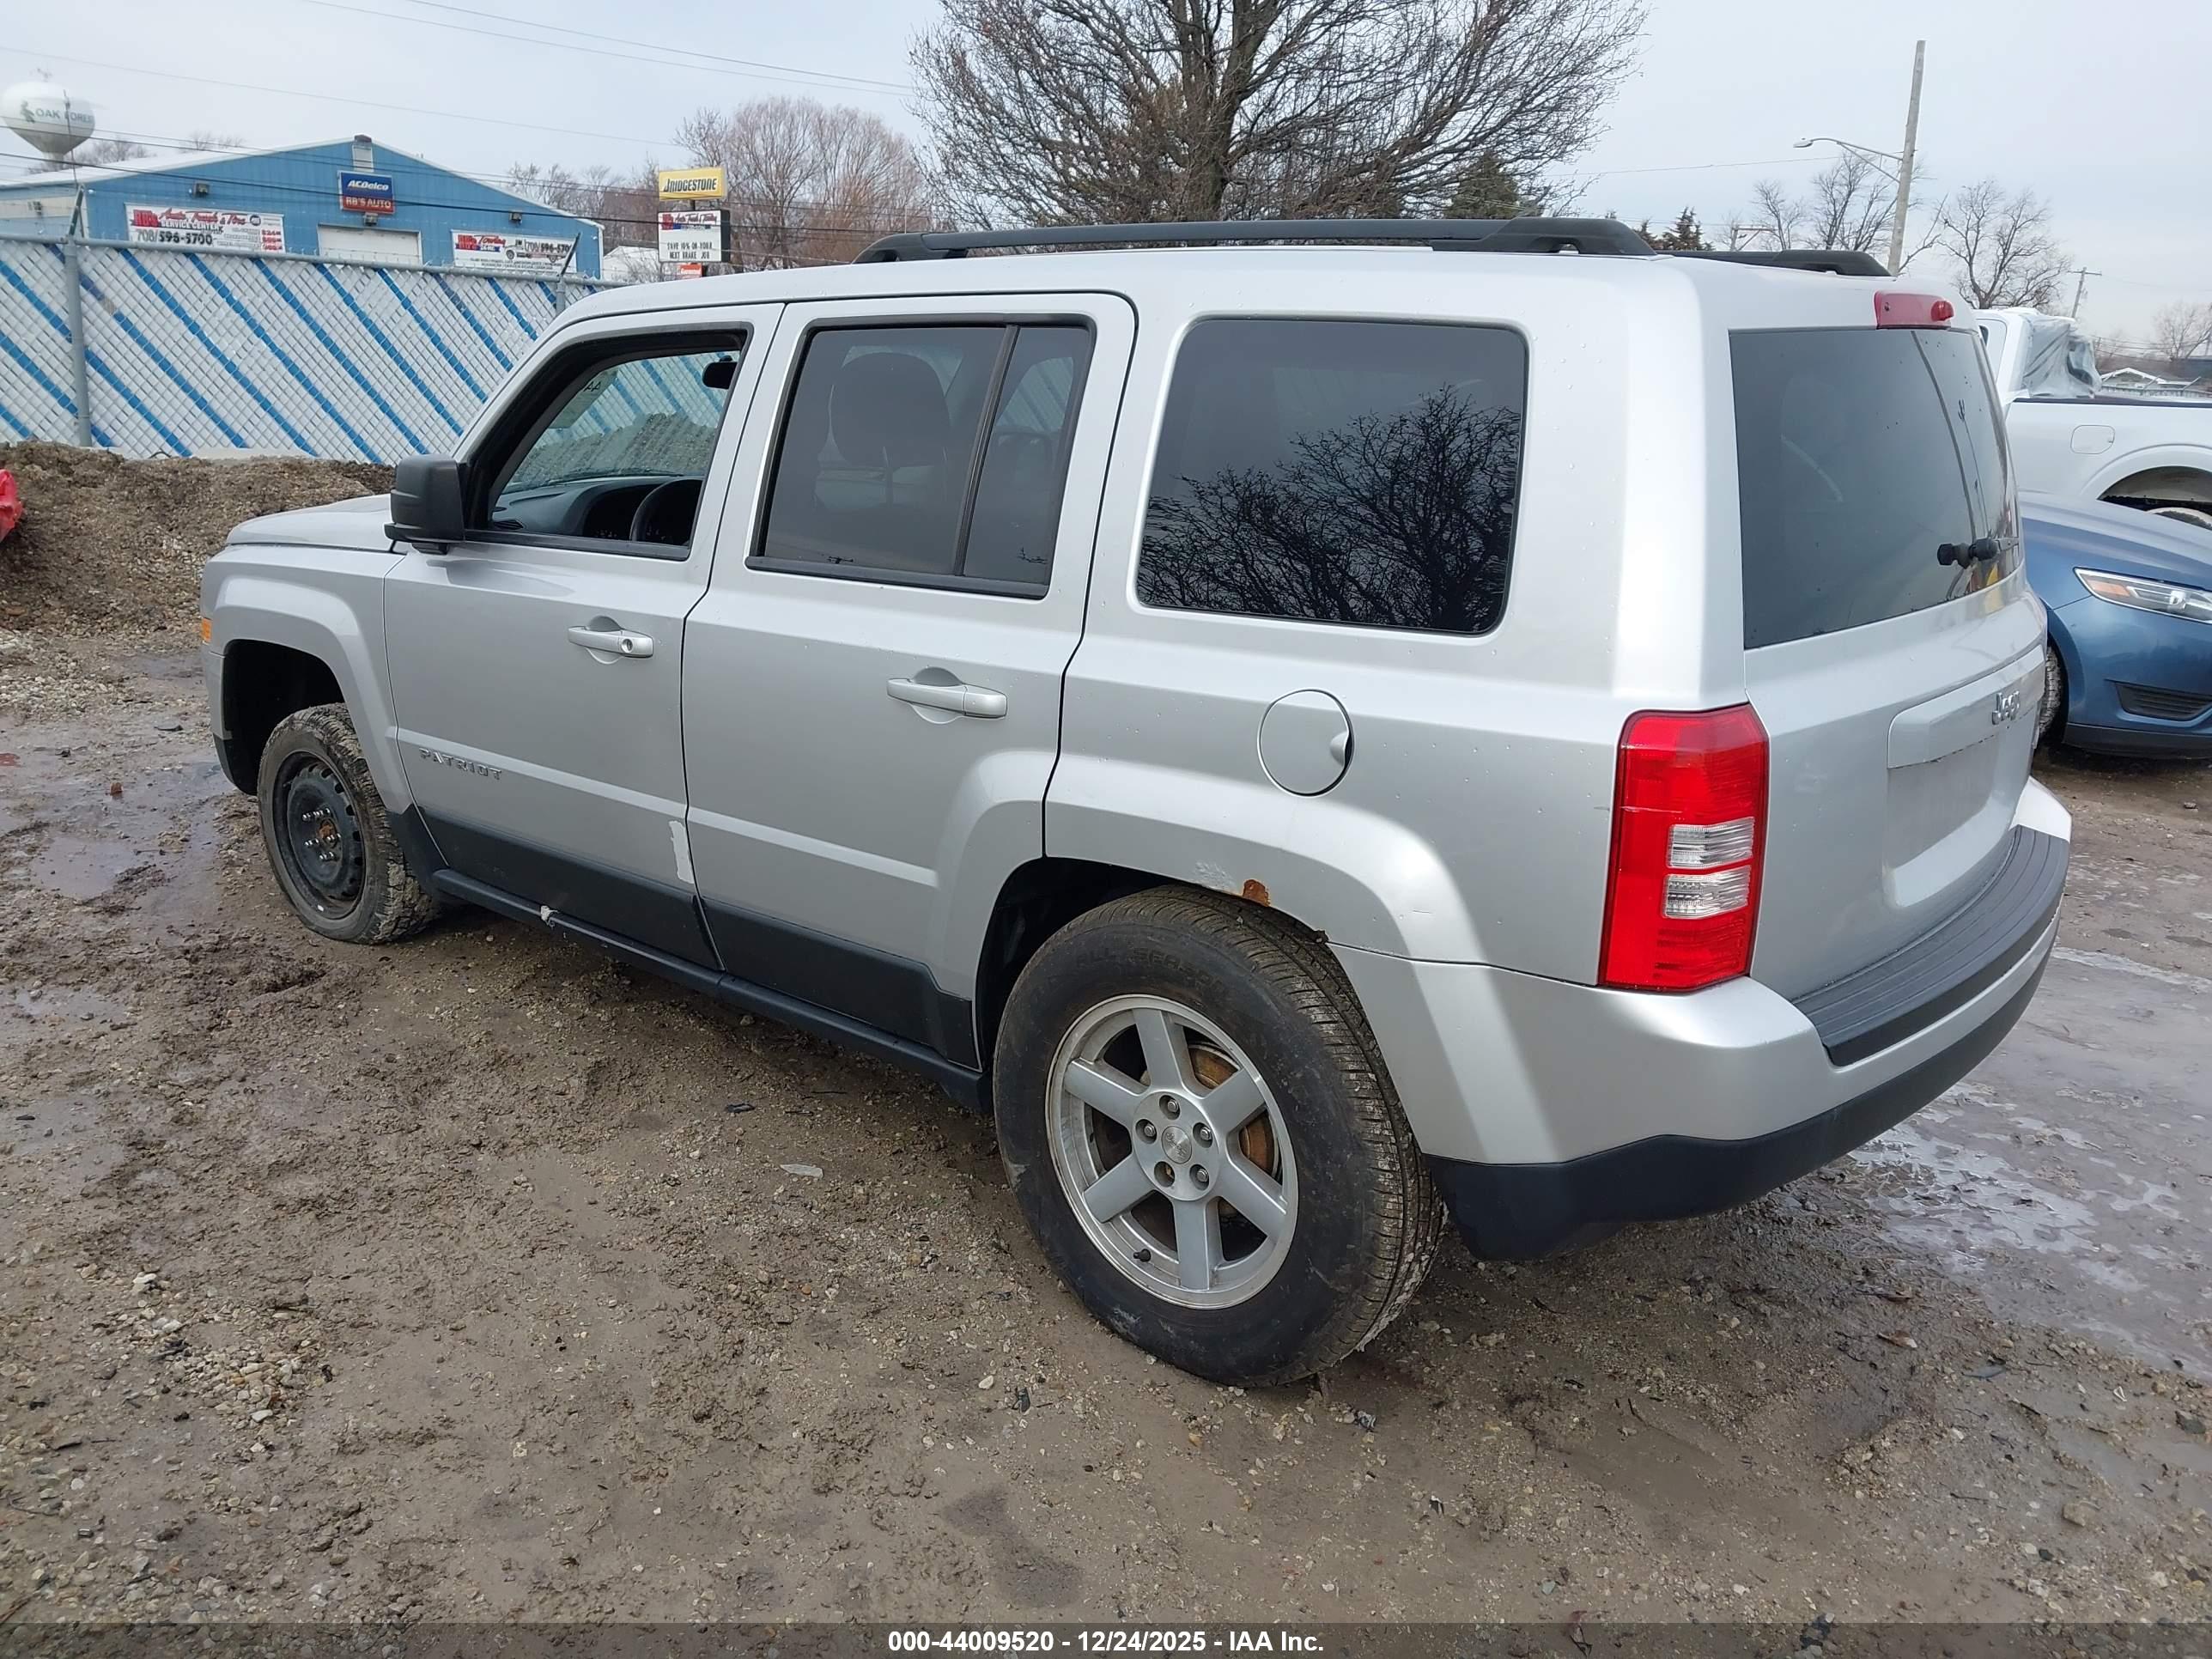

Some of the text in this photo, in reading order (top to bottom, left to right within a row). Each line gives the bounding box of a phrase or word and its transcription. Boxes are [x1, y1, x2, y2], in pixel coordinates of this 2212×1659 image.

[35, 108, 60, 118] OAK
[348, 179, 389, 191] ACDelco
[664, 178, 717, 192] BRIDGESTONE
[367, 198, 392, 209] AUTO
[667, 242, 679, 251] SAVE
[669, 251, 680, 259] NEXT
[419, 746, 502, 781] PATRIOT
